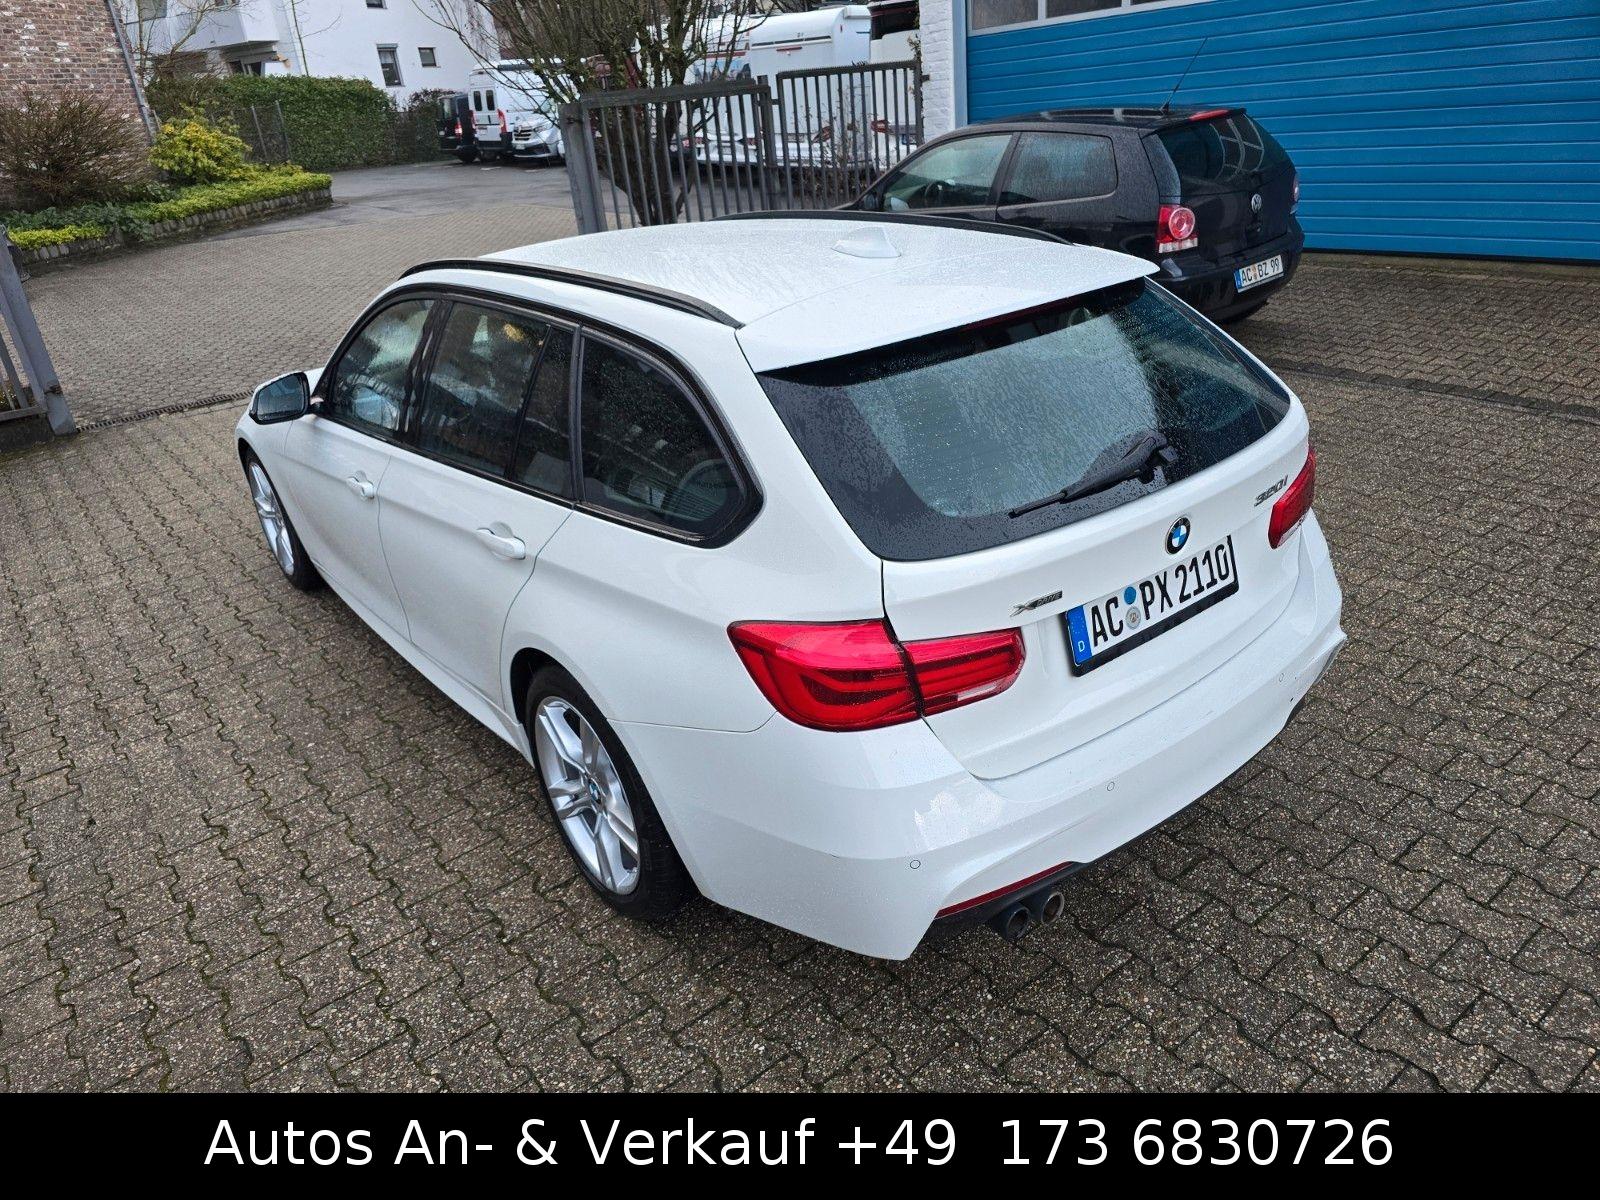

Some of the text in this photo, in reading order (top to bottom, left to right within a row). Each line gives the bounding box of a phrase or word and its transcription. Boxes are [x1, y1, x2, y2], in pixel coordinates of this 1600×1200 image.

[1242, 258, 1280, 285] AC BZ 99
[1091, 597, 1124, 647] AC
[1139, 571, 1173, 620] PX
[1175, 544, 1230, 604] 2110
[1078, 640, 1085, 653] D
